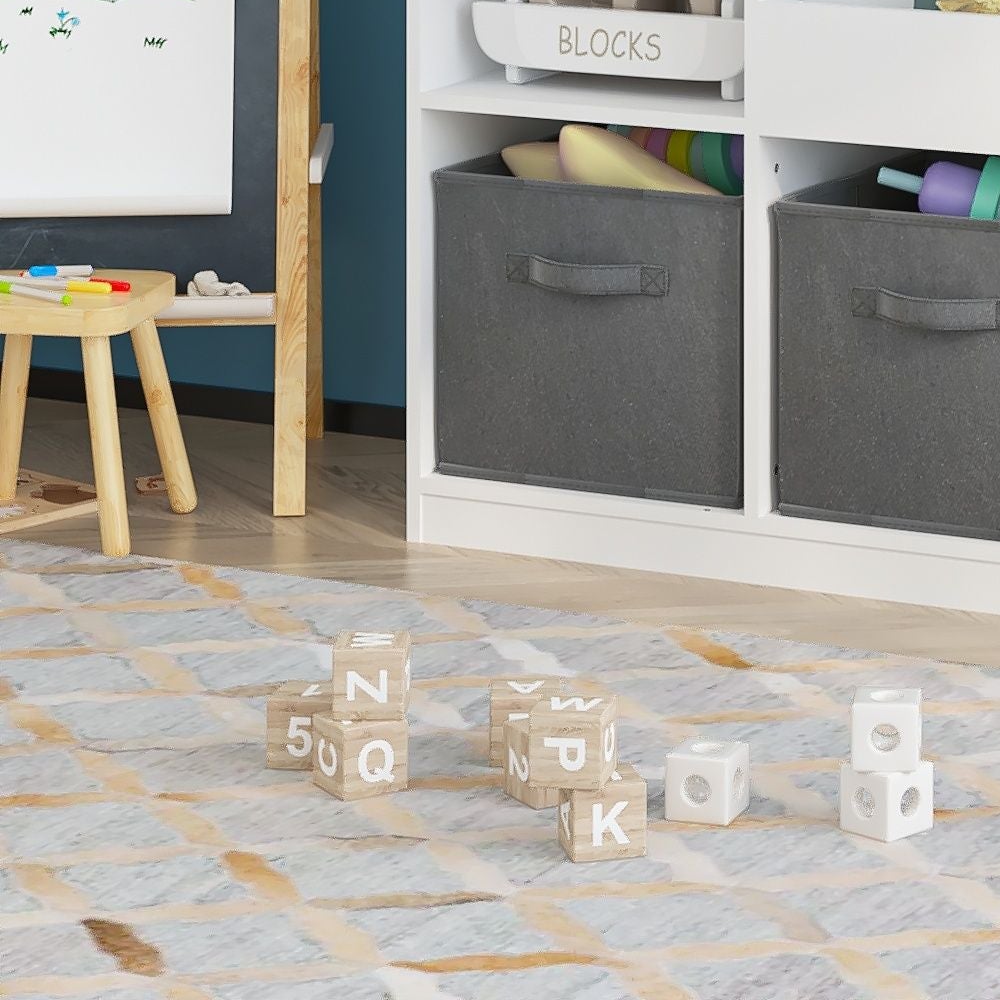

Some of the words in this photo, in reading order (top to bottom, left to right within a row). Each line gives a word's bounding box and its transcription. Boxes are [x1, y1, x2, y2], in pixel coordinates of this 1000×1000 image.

[559, 24, 662, 62] BLOCKS
[345, 669, 389, 704] N
[285, 716, 314, 759] 5
[543, 736, 588, 772] P
[357, 739, 396, 785] Q
[592, 800, 631, 847] K
